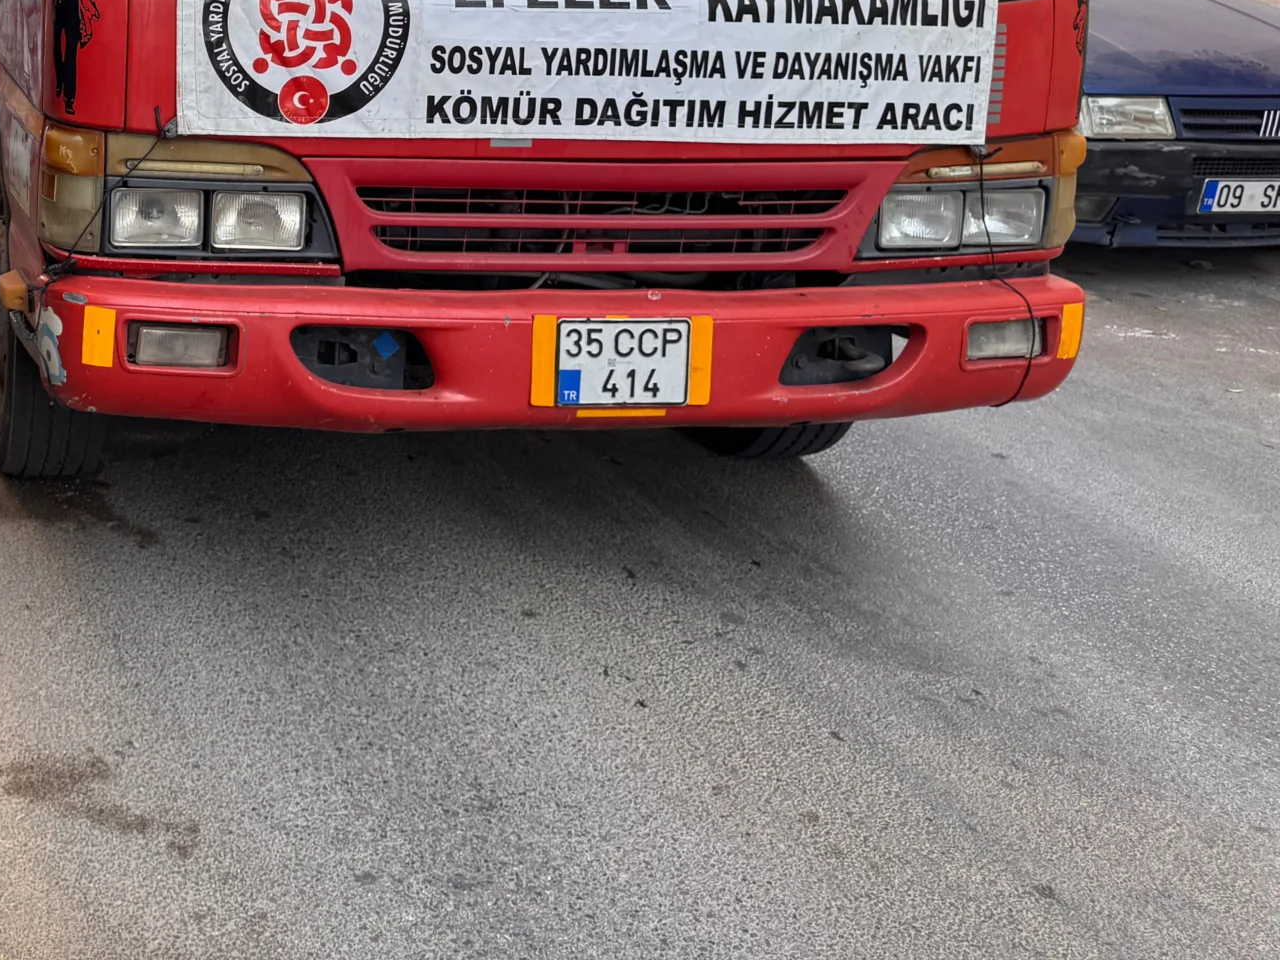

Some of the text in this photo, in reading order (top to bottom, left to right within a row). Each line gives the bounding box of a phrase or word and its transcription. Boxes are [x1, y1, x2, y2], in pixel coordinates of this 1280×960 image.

[213, 43, 250, 93] SOSYAL
[360, 1, 408, 97] MÜDÜRLÜĞÜ
[430, 45, 982, 89] SOSYAL YARDIMLAŞMA VE DAYANIŞMA VAKFI
[426, 89, 975, 131] KÖMÜR DAĞITIM HİZMET ARACI
[1204, 198, 1214, 206] TR
[1217, 184, 1245, 209] 09
[565, 328, 683, 358] 35 CCP
[563, 390, 578, 401] TR
[601, 368, 660, 399] 414
